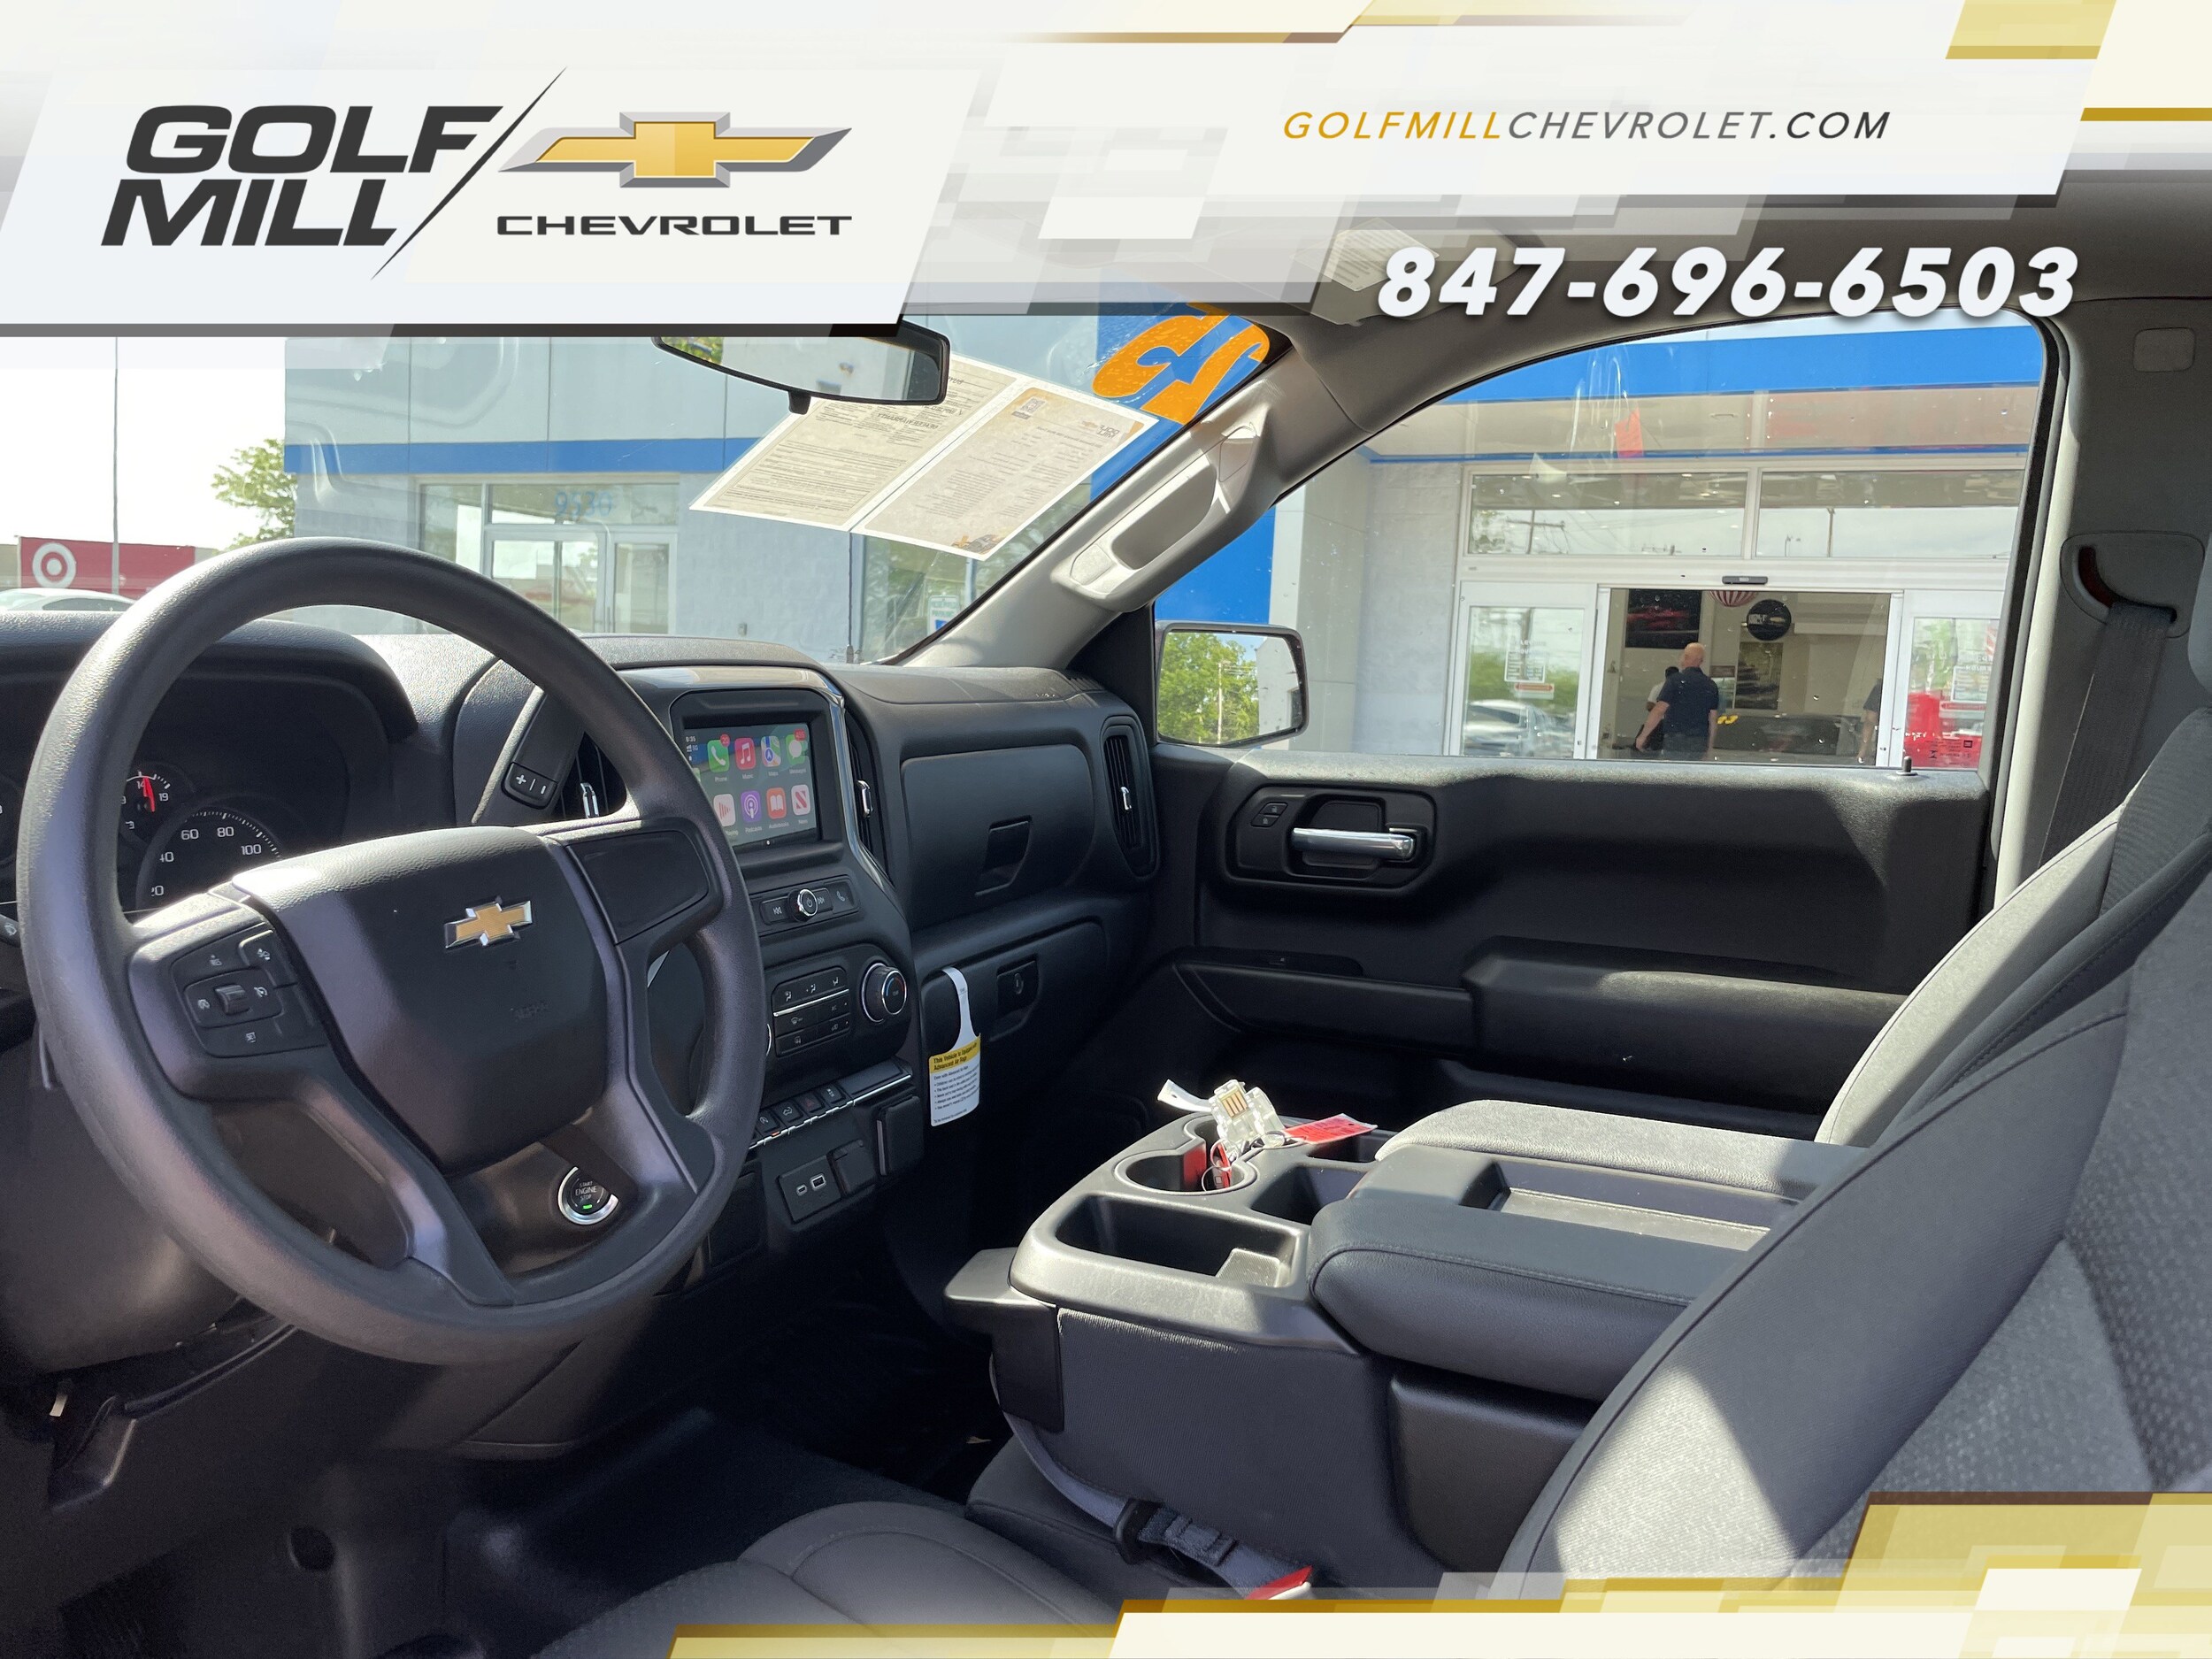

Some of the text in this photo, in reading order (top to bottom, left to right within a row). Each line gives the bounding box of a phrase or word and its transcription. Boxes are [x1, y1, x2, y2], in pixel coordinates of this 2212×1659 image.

[158, 792, 169, 802] 19
[180, 826, 234, 841] 60 80
[241, 843, 262, 856] 100
[575, 1187, 597, 1195] ENGINE
